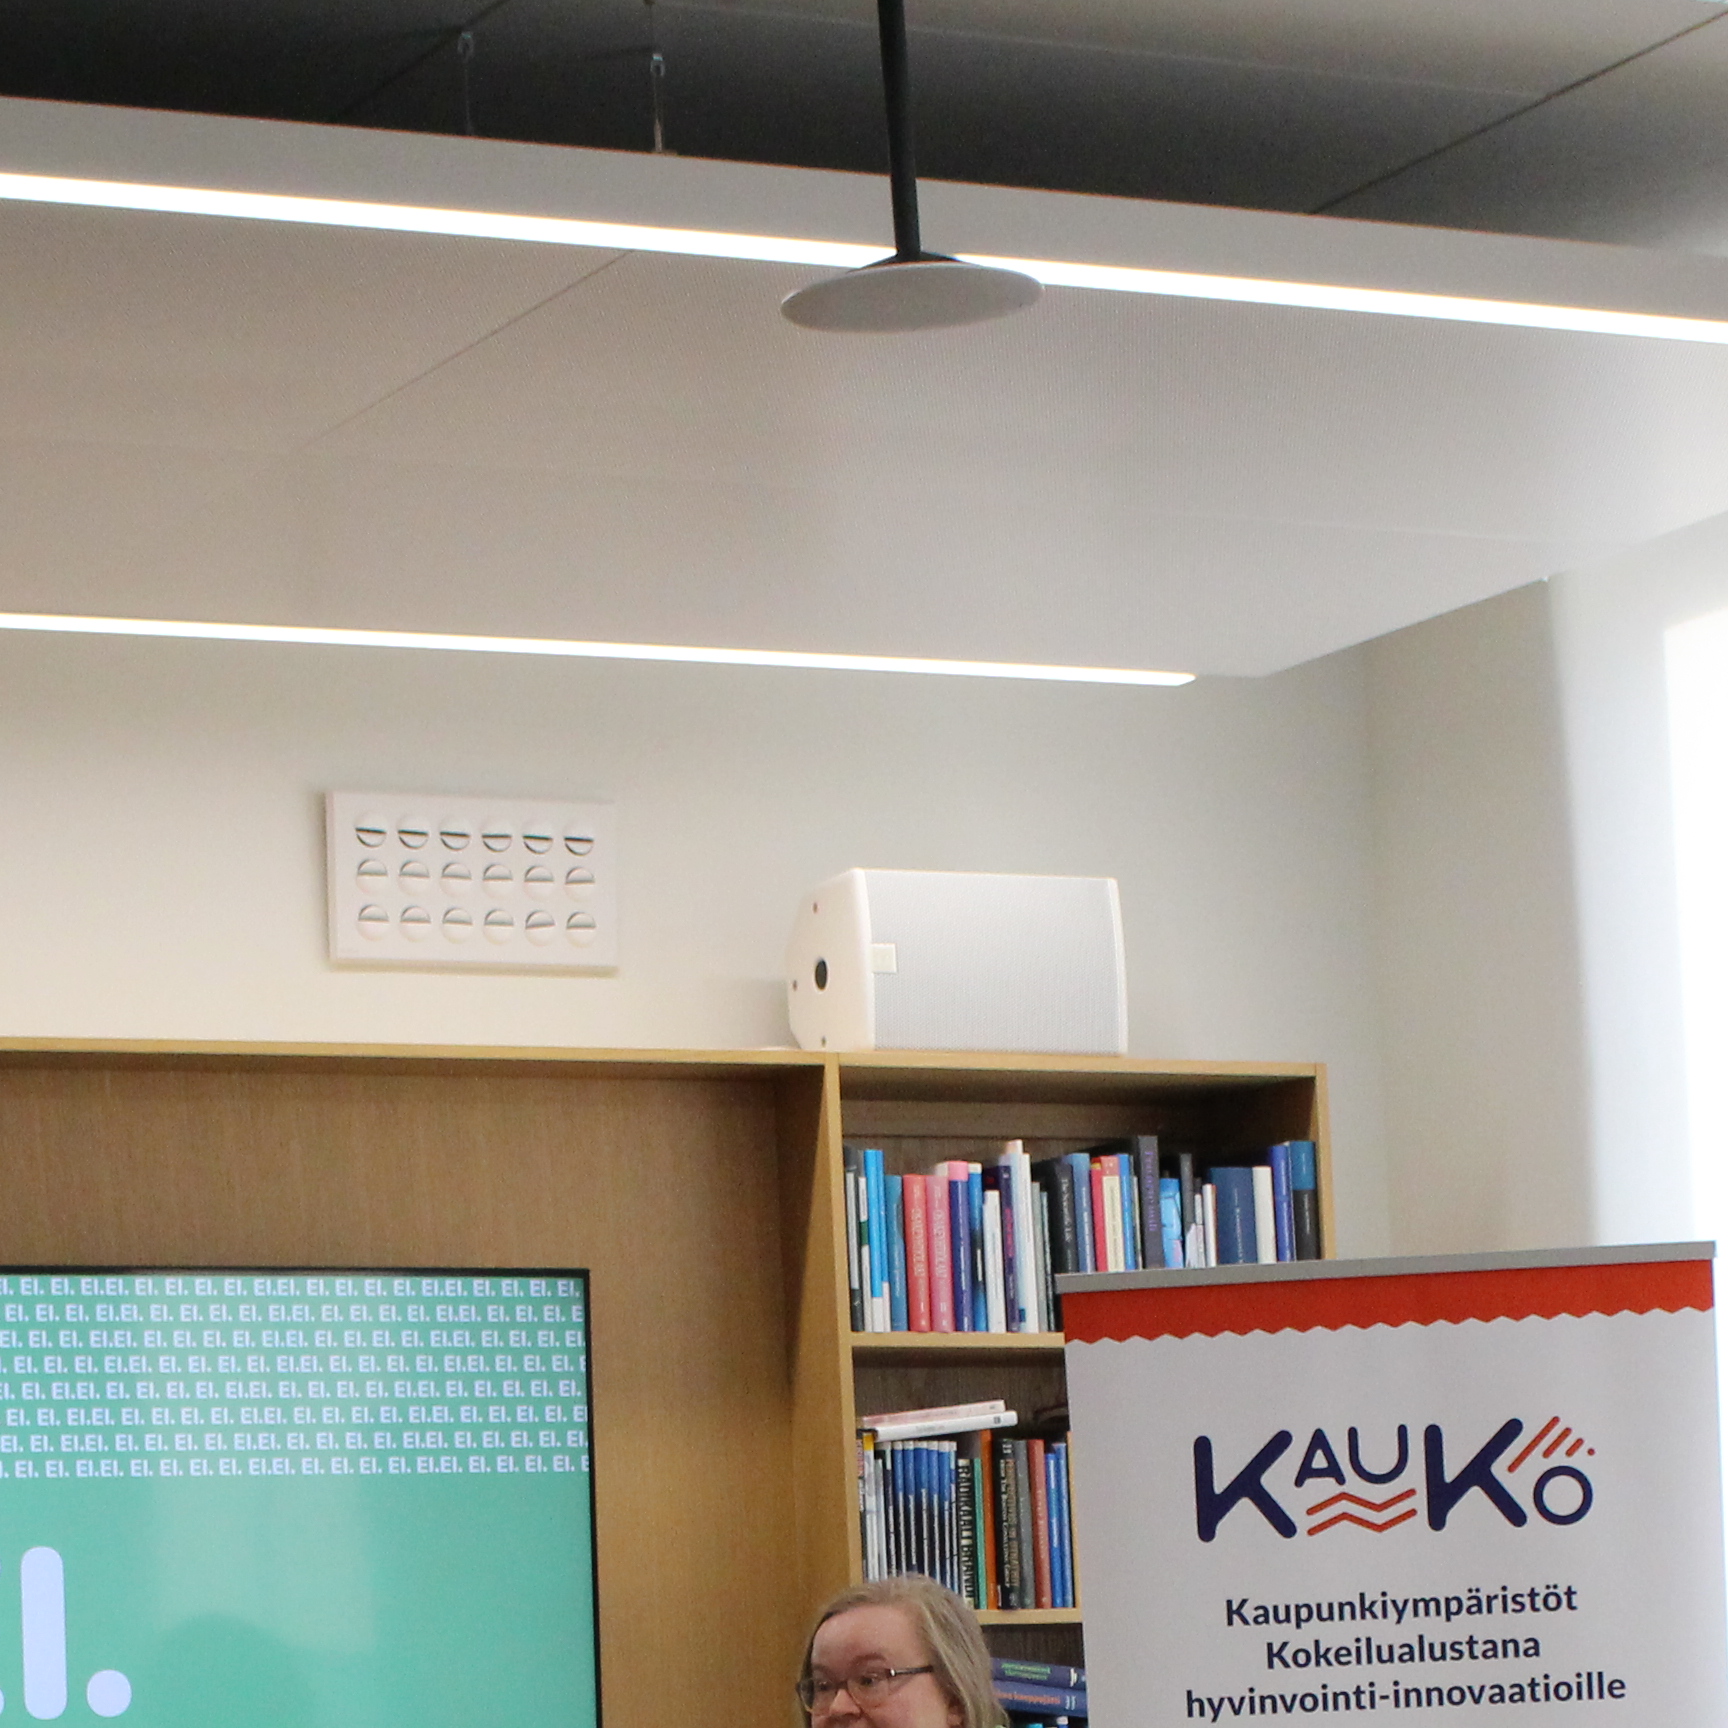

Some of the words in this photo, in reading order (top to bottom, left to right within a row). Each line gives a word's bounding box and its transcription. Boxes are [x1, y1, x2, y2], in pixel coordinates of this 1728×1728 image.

[15, 1460, 38, 1478] EI.
[46, 1460, 69, 1478] EI.
[130, 1459, 153, 1476] EI.
[160, 1459, 182, 1476] EI.
[190, 1460, 213, 1475] EI.
[220, 1459, 242, 1474] EI.
[302, 1458, 324, 1474] EI.
[332, 1458, 354, 1474] EI.
[359, 1456, 382, 1474] EI.
[389, 1456, 411, 1473] EI.
[469, 1456, 491, 1472] EI.
[496, 1455, 519, 1472] EI.
[525, 1455, 547, 1472] EI.
[554, 1456, 576, 1472] EI.
[1193, 1417, 1595, 1543] KAUKO
[1224, 1584, 1579, 1628] Kaupunkiympäristöt
[1265, 1634, 1542, 1671] Kokeilualustana
[1185, 1671, 1627, 1722] hyvinvointi-innovaatioille
